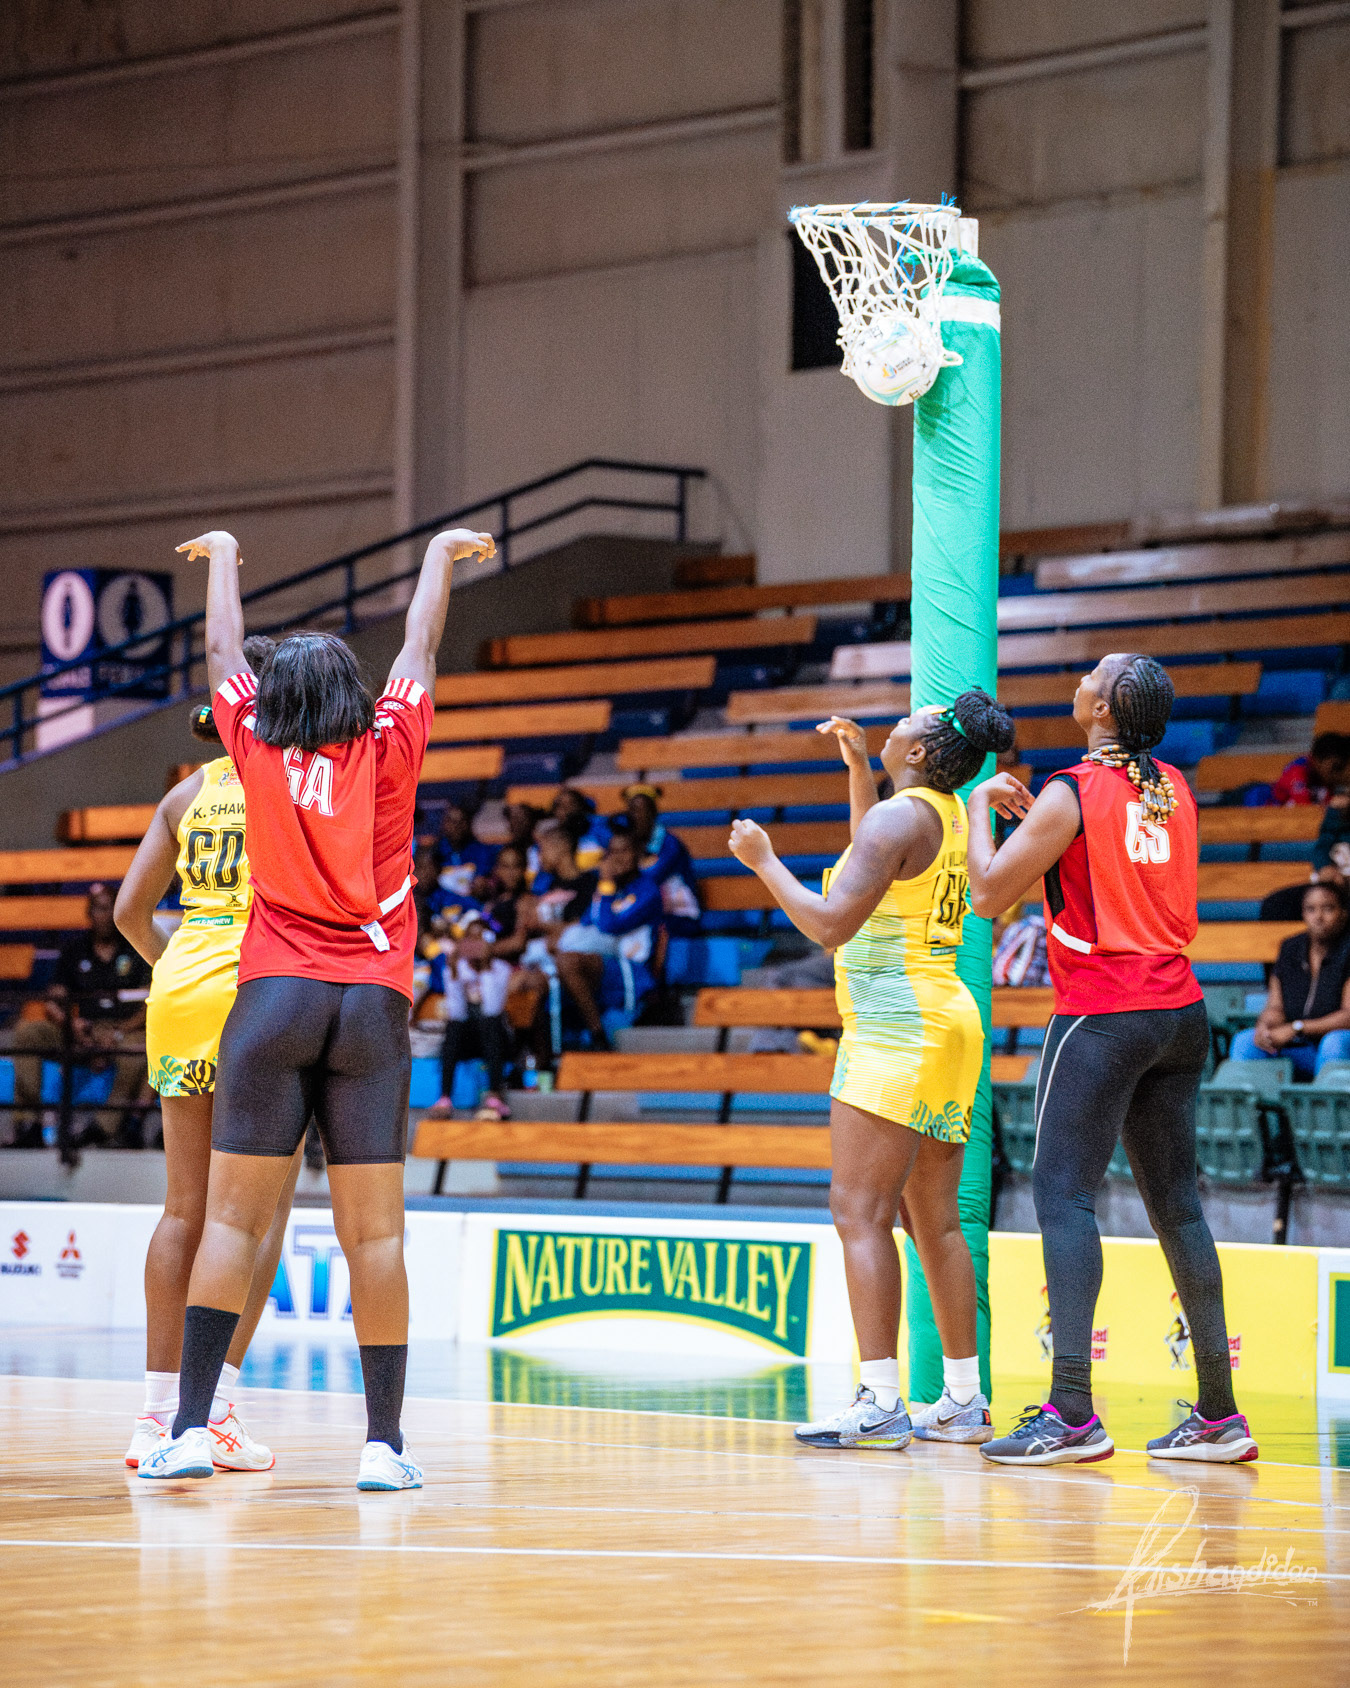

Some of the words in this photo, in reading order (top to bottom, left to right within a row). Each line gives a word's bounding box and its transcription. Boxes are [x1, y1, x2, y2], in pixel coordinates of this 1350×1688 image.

[193, 807, 206, 820] K.
[210, 803, 245, 816] SHAW
[282, 745, 334, 816] GA
[185, 827, 247, 891] GD
[1125, 801, 1170, 864] GS
[501, 1233, 652, 1324] NATURE
[656, 1239, 802, 1340] VALLEY
